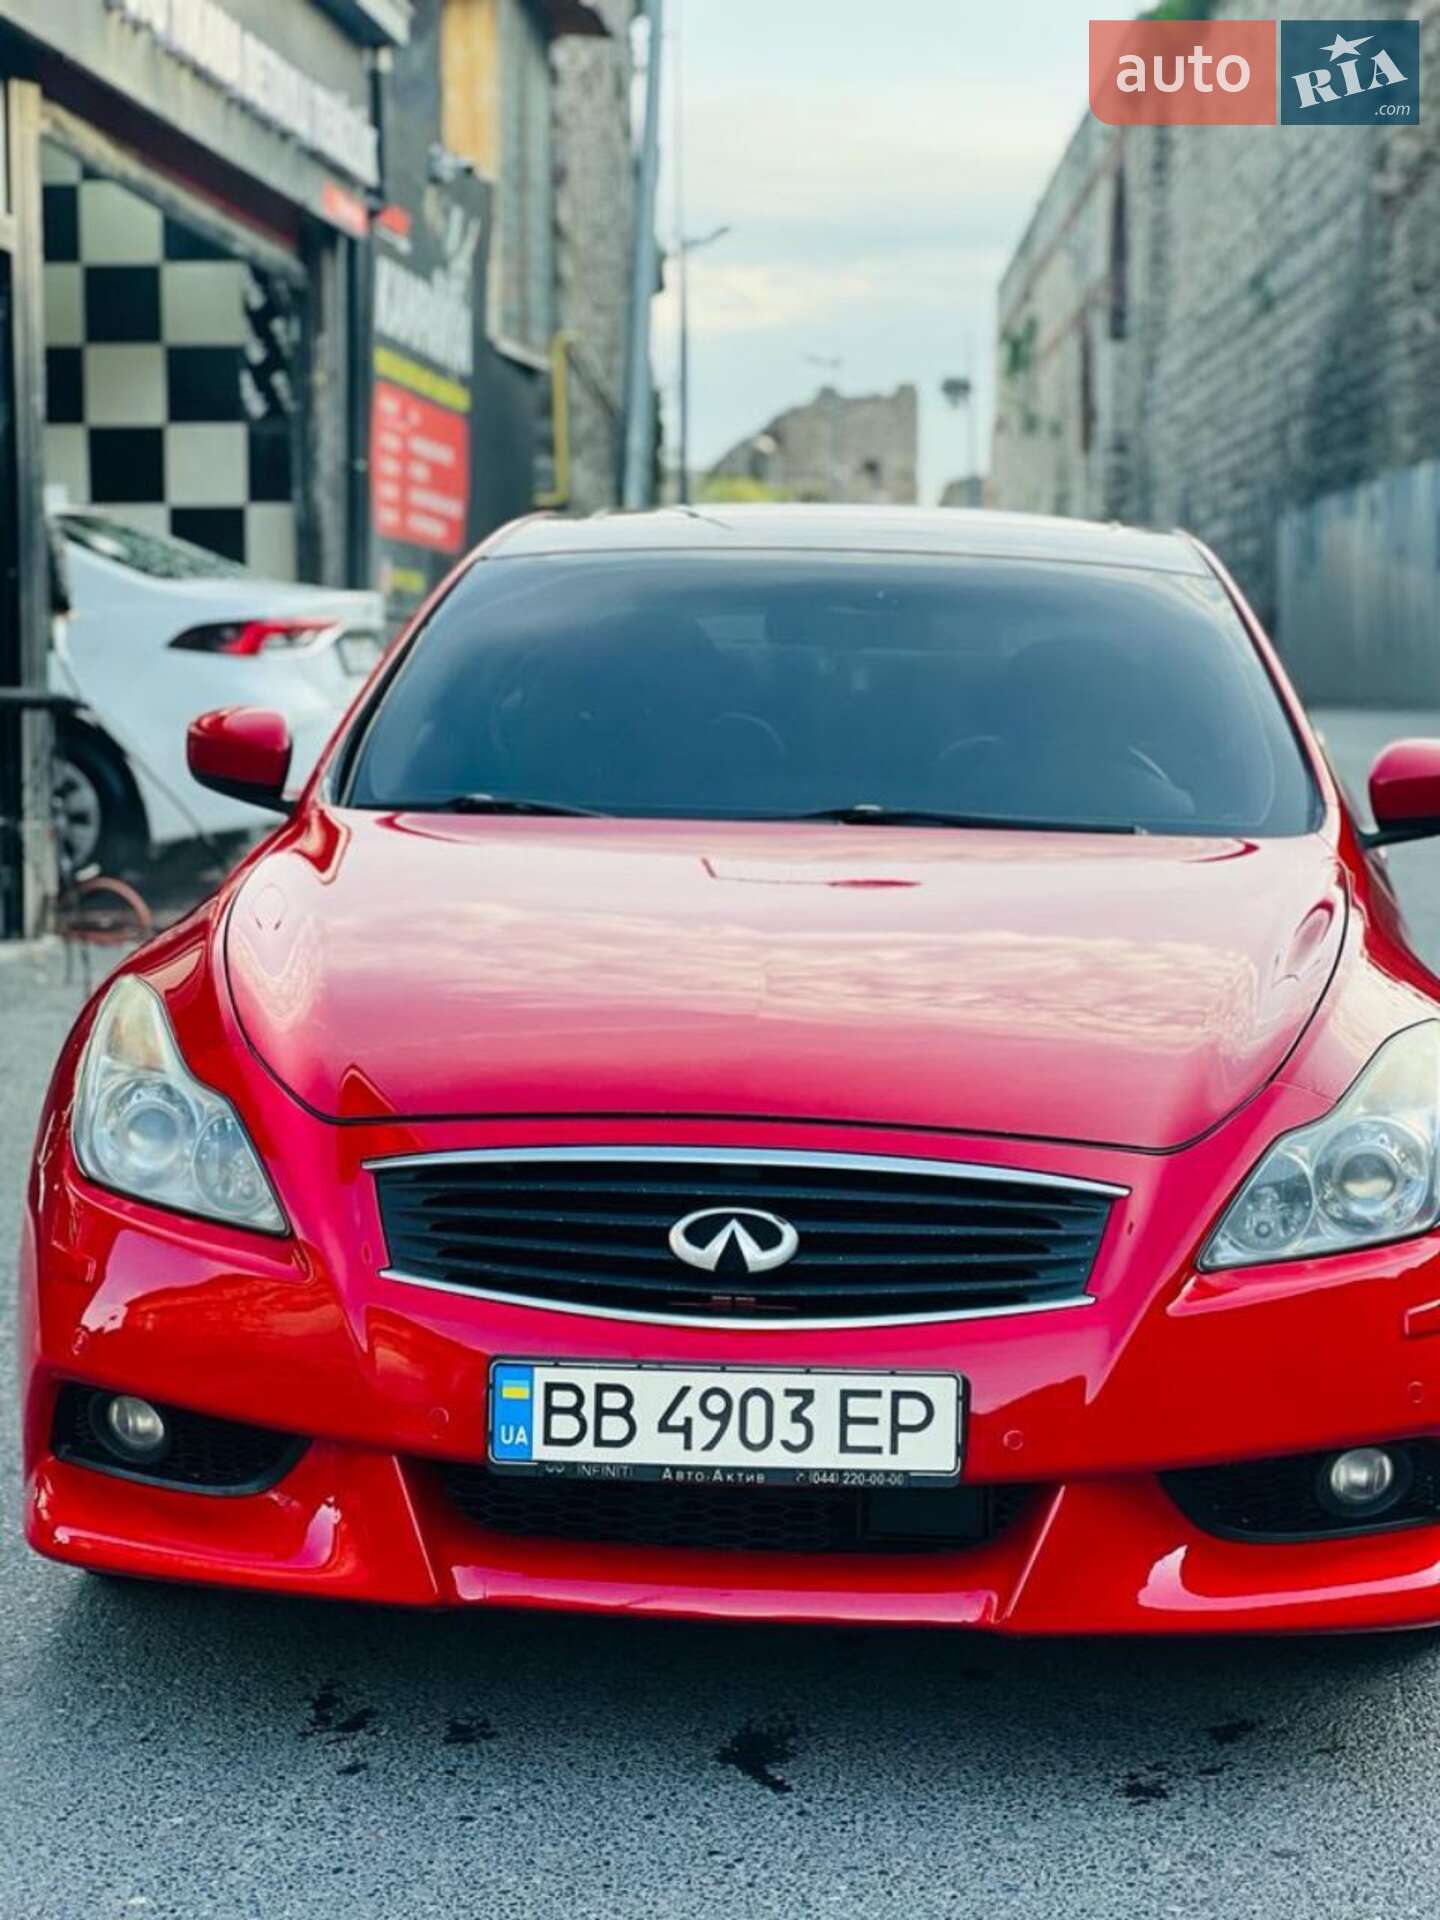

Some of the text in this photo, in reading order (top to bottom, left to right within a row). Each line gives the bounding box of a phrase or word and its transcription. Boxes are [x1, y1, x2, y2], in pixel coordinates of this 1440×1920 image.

[501, 1424, 528, 1446] UA
[542, 1382, 936, 1456] BB 4903 EP
